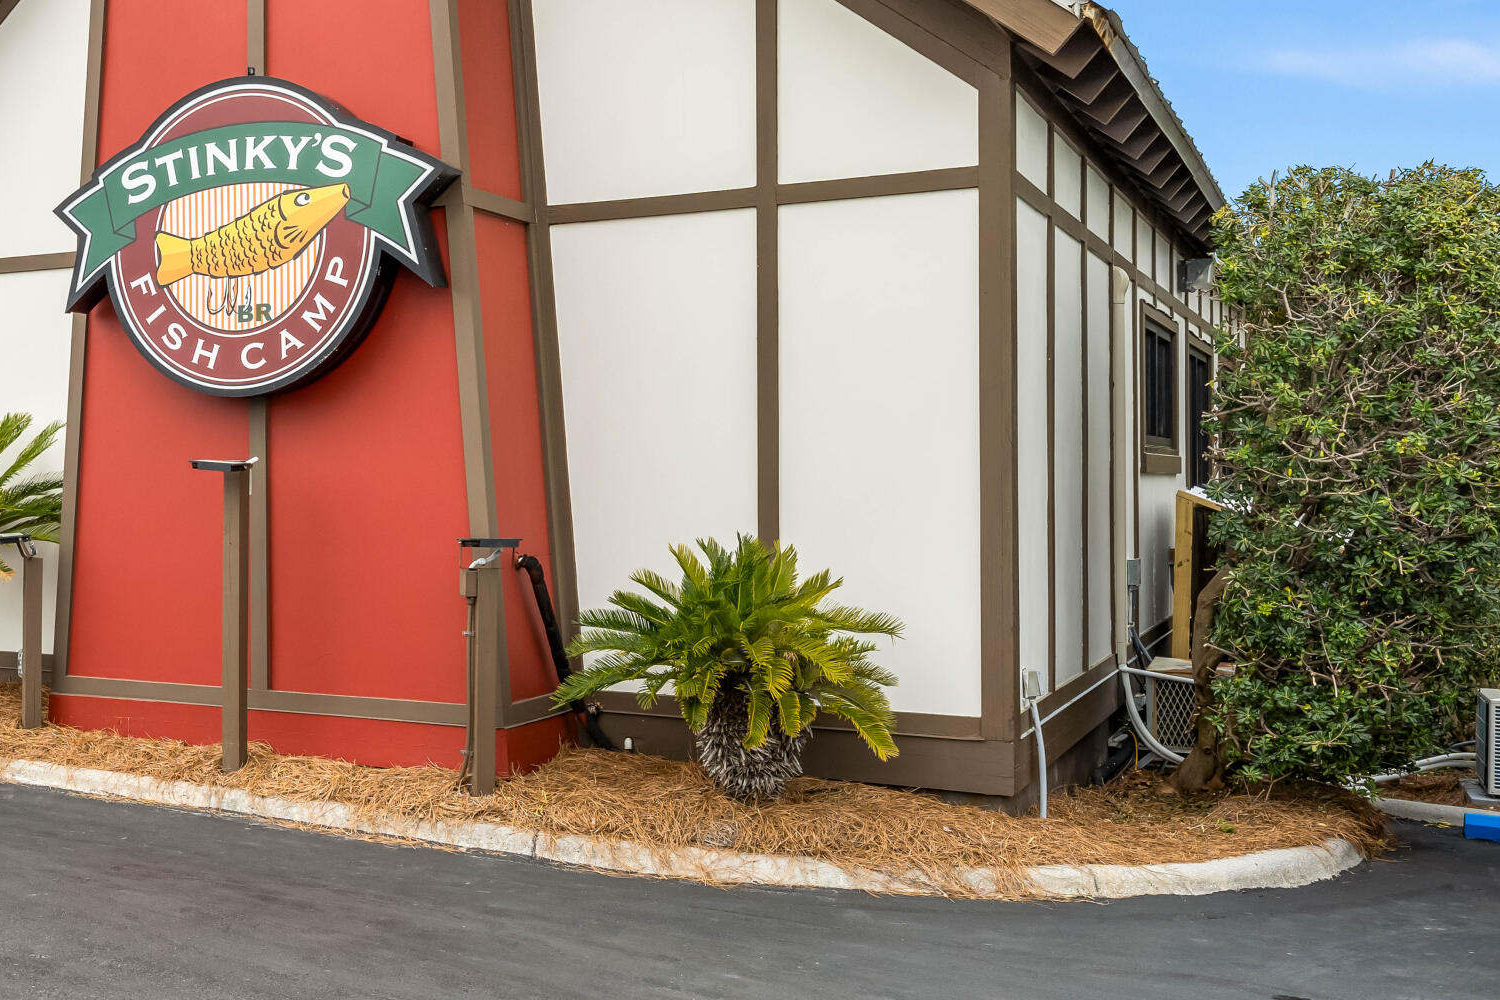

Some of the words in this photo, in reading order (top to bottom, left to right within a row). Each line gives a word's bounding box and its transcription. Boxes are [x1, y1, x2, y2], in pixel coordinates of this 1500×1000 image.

[121, 133, 358, 204] STINKY'S
[130, 272, 220, 370] FISH
[240, 256, 349, 370] CAMP
[237, 303, 273, 323] BR
